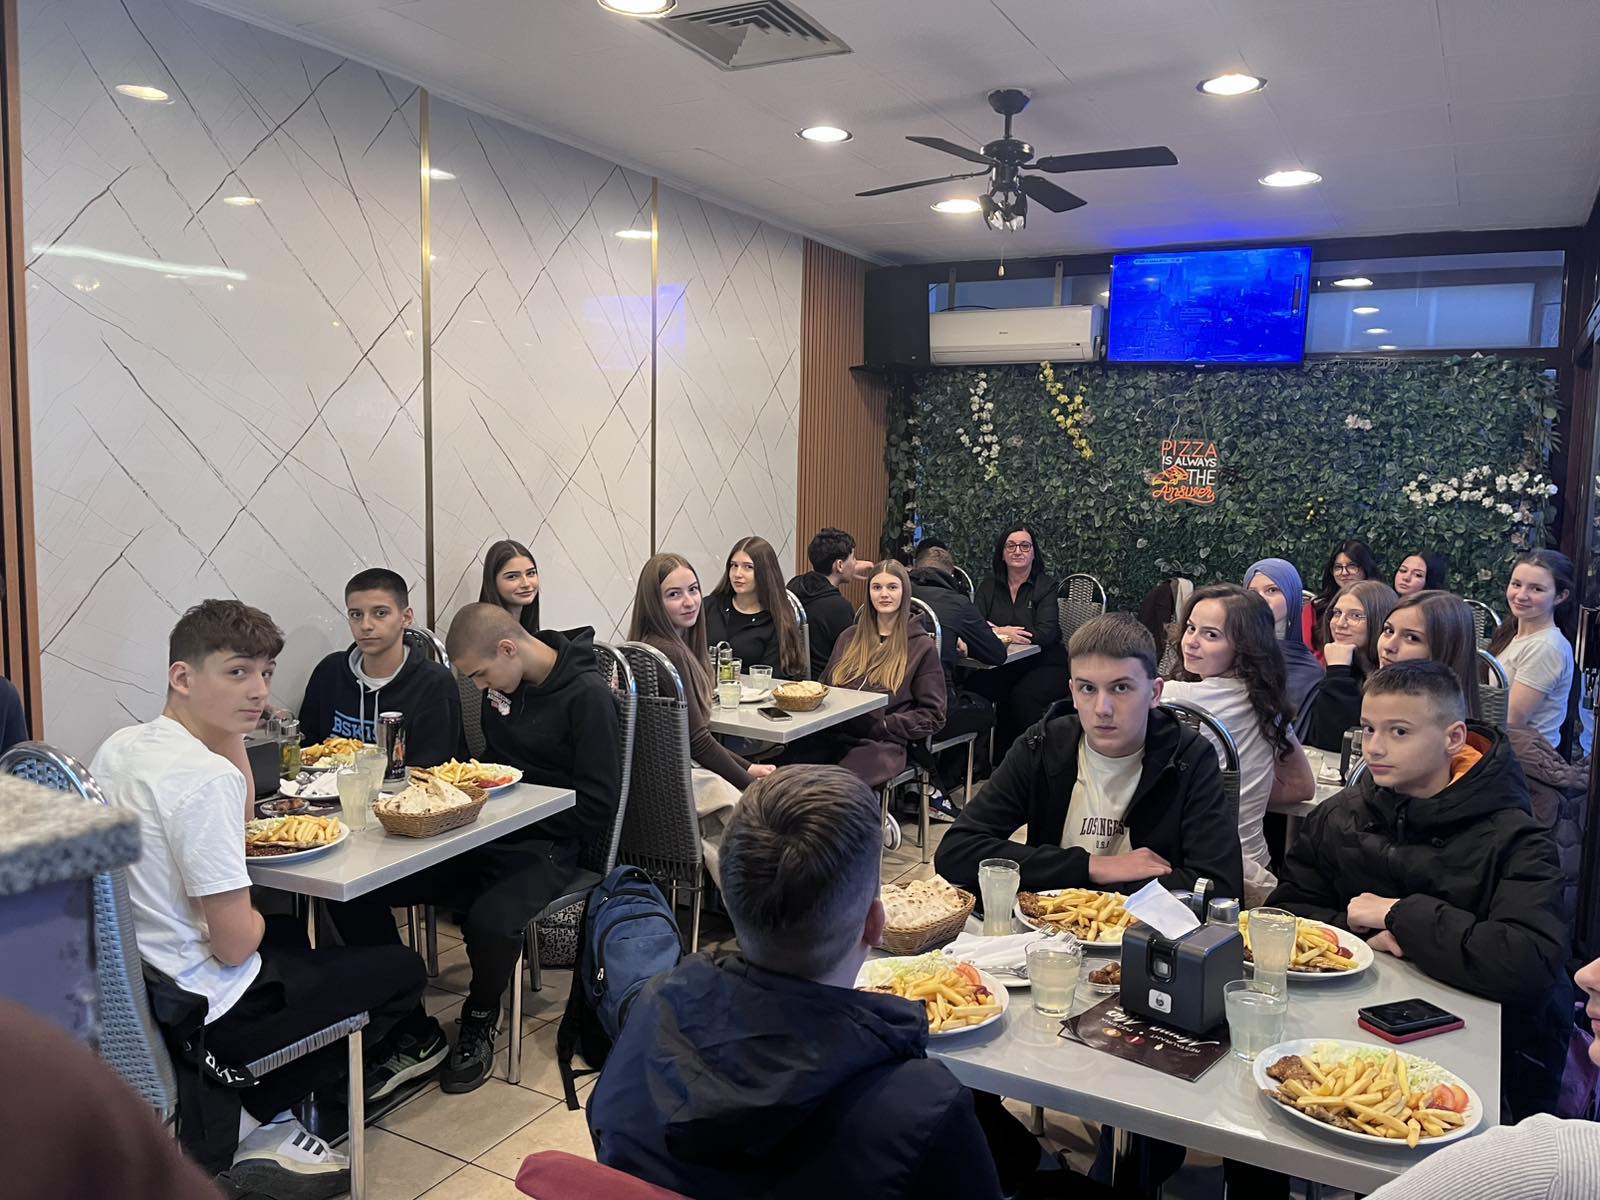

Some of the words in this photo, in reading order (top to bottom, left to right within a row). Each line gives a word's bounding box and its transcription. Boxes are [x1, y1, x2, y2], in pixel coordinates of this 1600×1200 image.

[1161, 440, 1217, 458] PIZZA
[1162, 456, 1173, 466] IS
[1174, 457, 1217, 468] ALWAYS
[1186, 469, 1216, 486] THE
[1152, 485, 1216, 504] Answer
[1150, 1034, 1201, 1054] RESTAURANT
